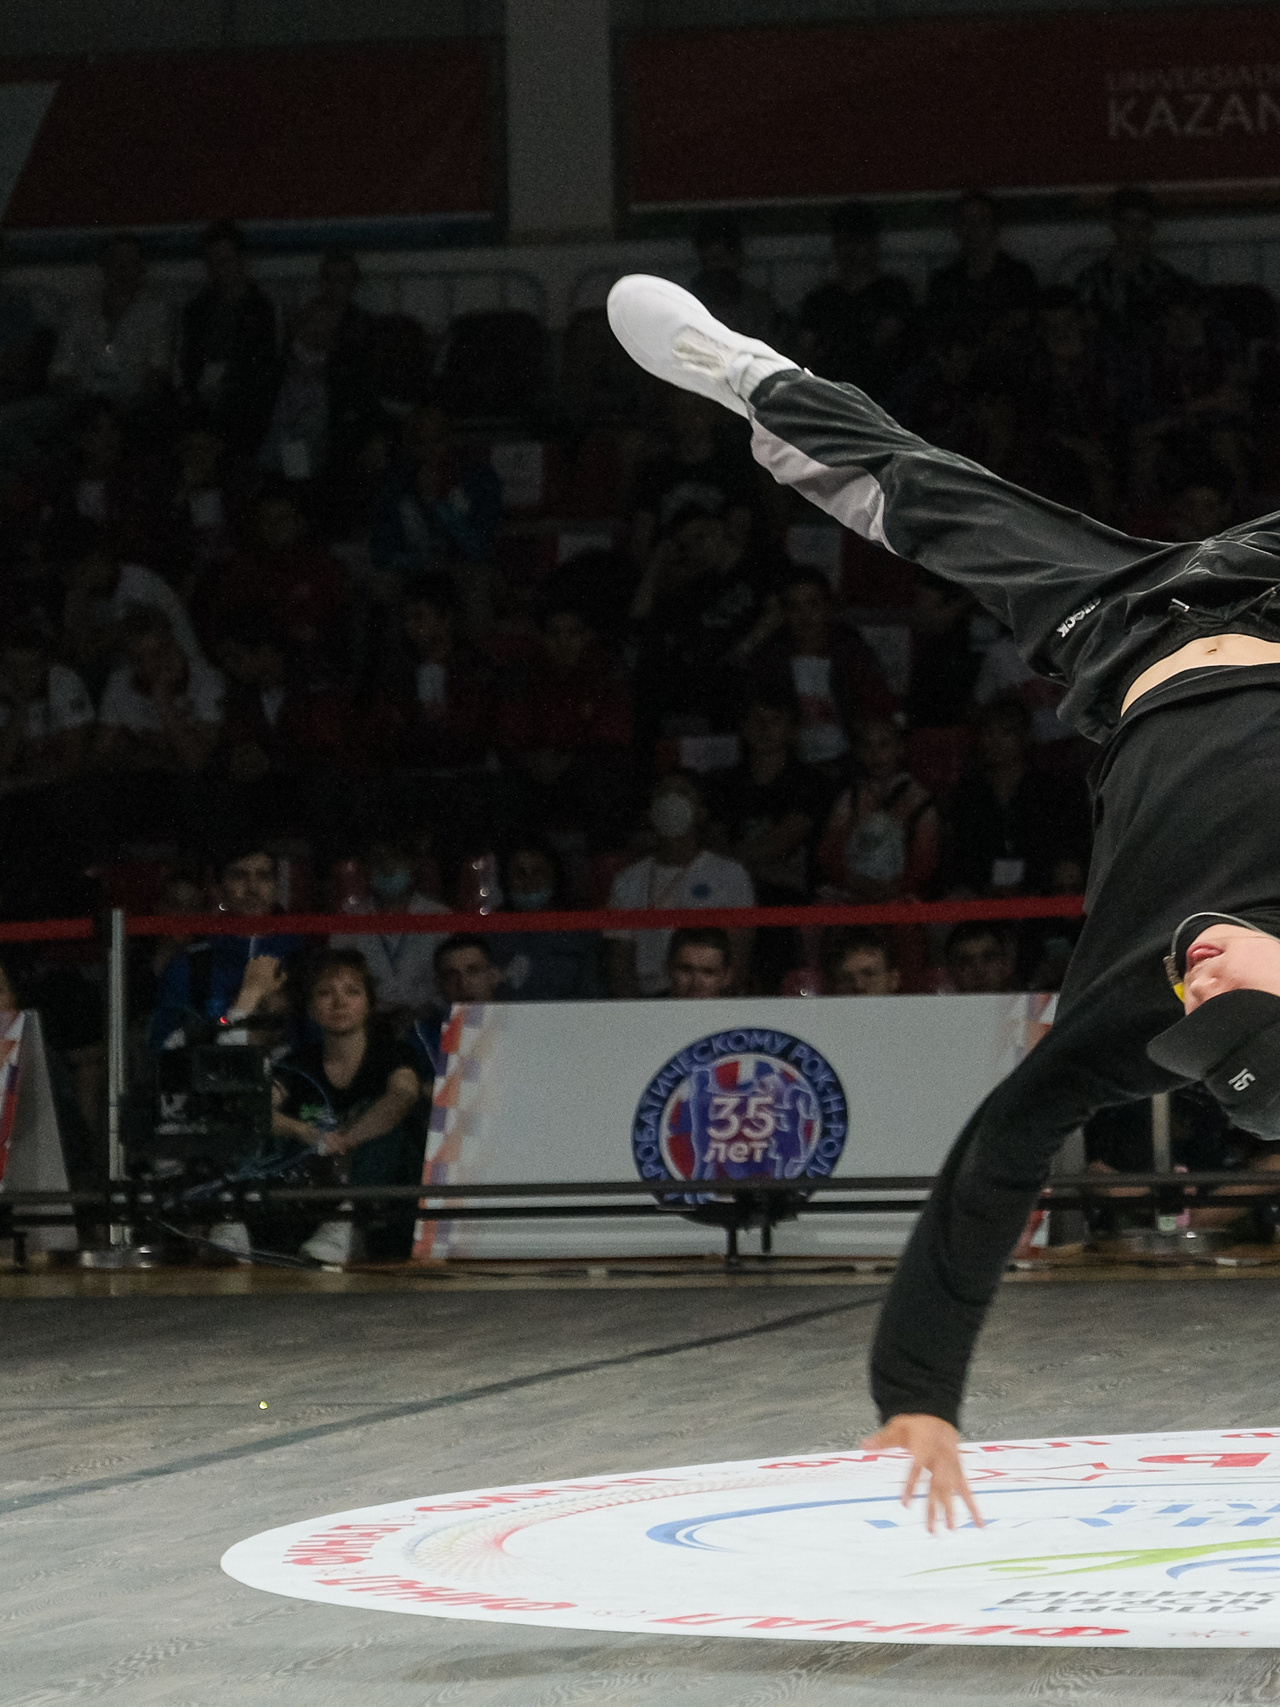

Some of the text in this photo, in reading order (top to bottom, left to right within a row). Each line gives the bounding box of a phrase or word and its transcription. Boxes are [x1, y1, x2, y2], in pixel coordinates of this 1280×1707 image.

[633, 1029, 792, 1181] РОБАТИЧЕСКОМУ
[707, 1096, 777, 1141] 35
[702, 1141, 769, 1164] лет
[758, 1440, 1111, 1469] ФИАЛ
[647, 1613, 1131, 1638] ФИНАЛ
